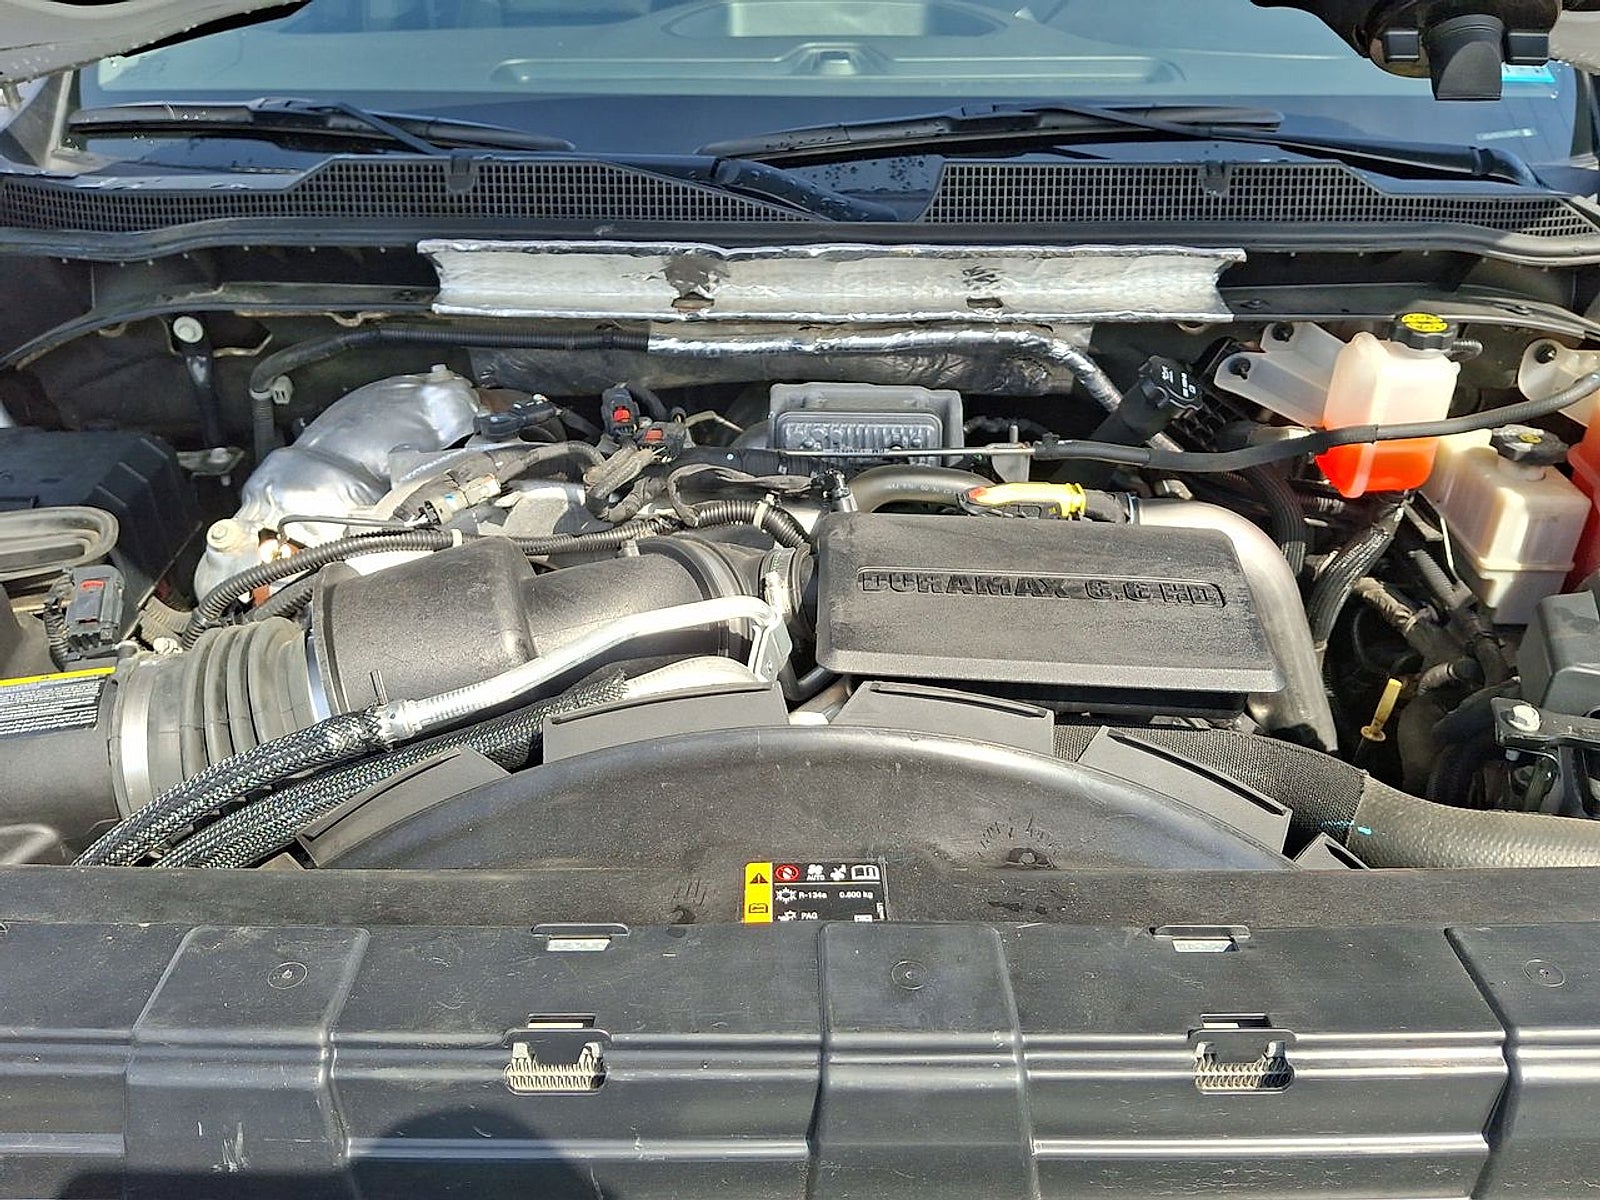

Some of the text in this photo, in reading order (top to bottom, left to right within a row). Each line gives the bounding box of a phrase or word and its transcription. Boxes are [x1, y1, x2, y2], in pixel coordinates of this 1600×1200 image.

[862, 571, 1220, 608] DURAMAX 6.6 HD
[799, 891, 827, 899] R-134a
